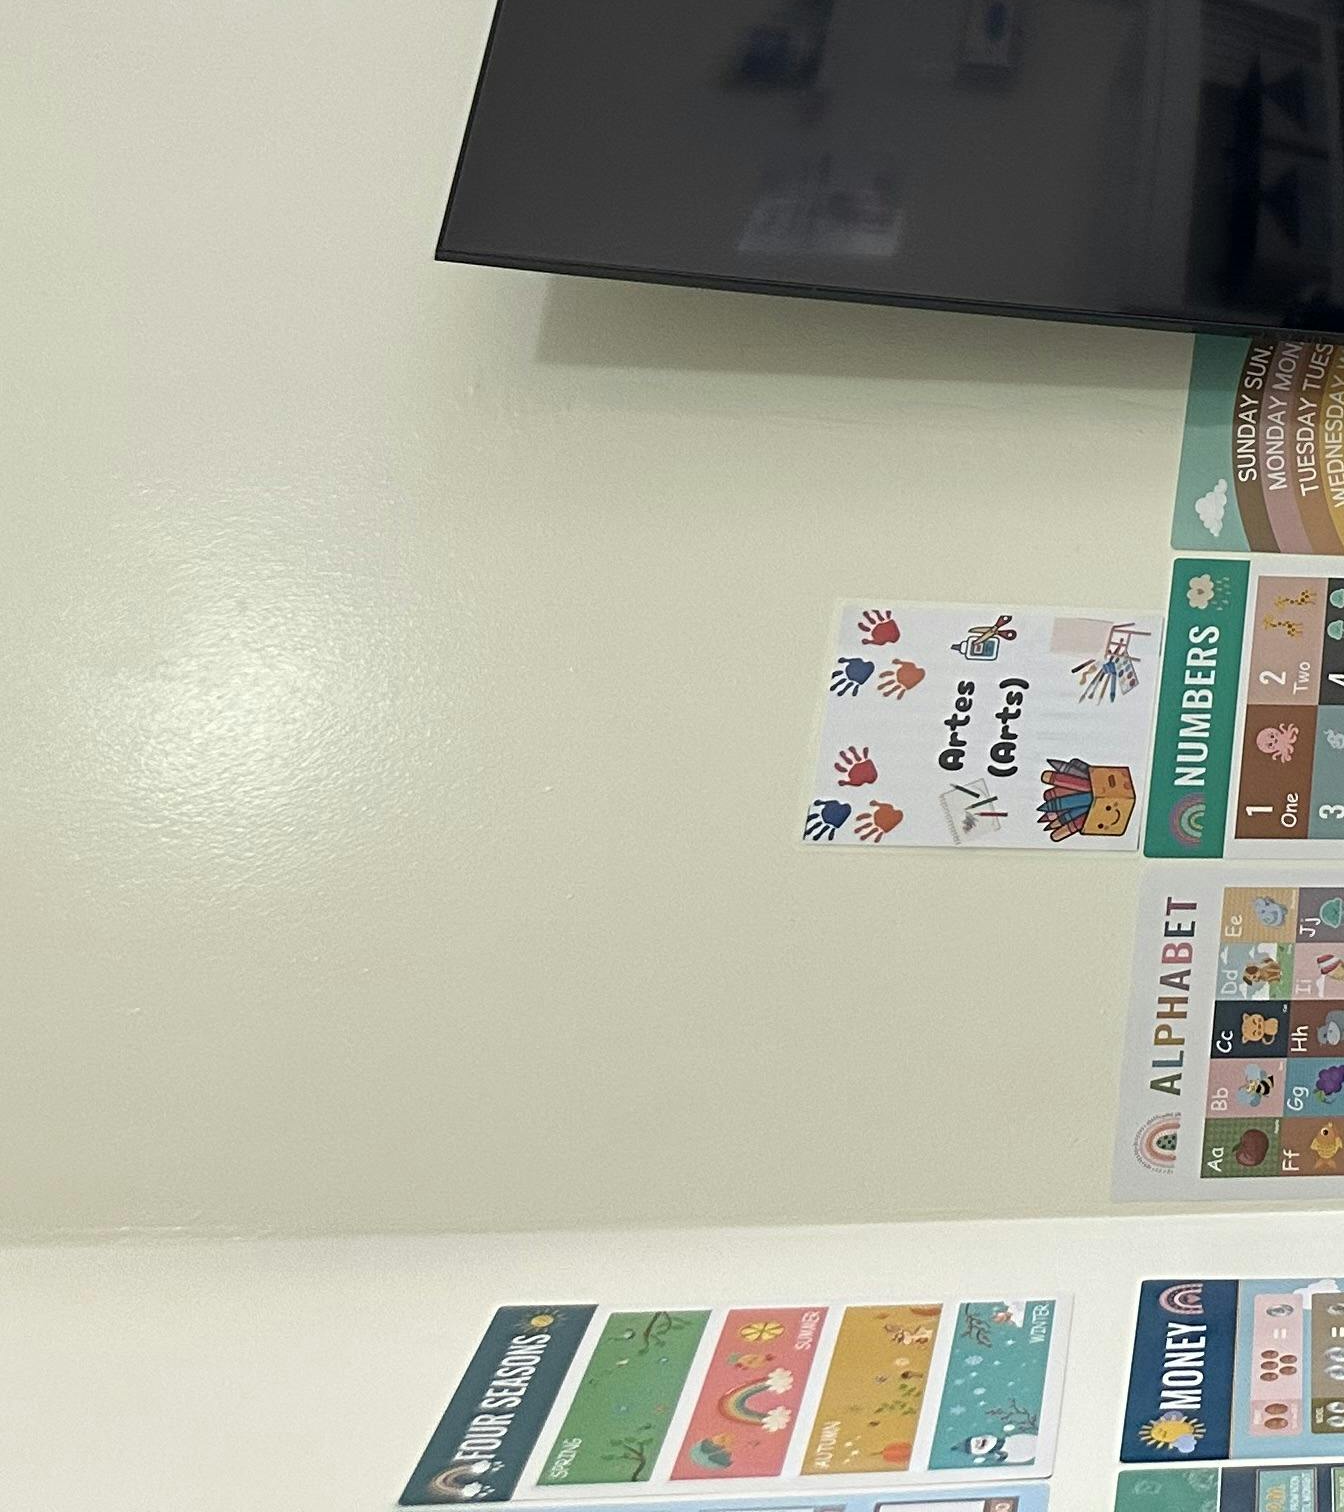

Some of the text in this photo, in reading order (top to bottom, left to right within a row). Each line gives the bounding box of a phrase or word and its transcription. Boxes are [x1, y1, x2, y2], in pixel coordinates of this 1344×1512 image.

[1237, 346, 1273, 482] SUNDAY SUN.
[1267, 396, 1288, 490] MONDAY
[1296, 397, 1321, 496] TUESDAY
[1259, 671, 1287, 684] 2
[1294, 661, 1311, 694] Two
[937, 680, 975, 771] Artes
[987, 678, 1030, 778] (Arts)
[1173, 624, 1221, 787] NUMBERS
[1246, 805, 1274, 816] 1
[1280, 793, 1299, 828] One
[1150, 897, 1197, 1096] ALPHABET
[1216, 1030, 1234, 1053] Cc
[1291, 1026, 1308, 1051] Hh
[795, 1312, 820, 1350] SUMMER
[1030, 1304, 1050, 1344] WINTER
[1160, 1322, 1207, 1410] MONEY
[454, 1334, 551, 1461] FOUR SEASONS
[551, 1438, 582, 1479] SPRING
[815, 1421, 841, 1468] AUTUMN
